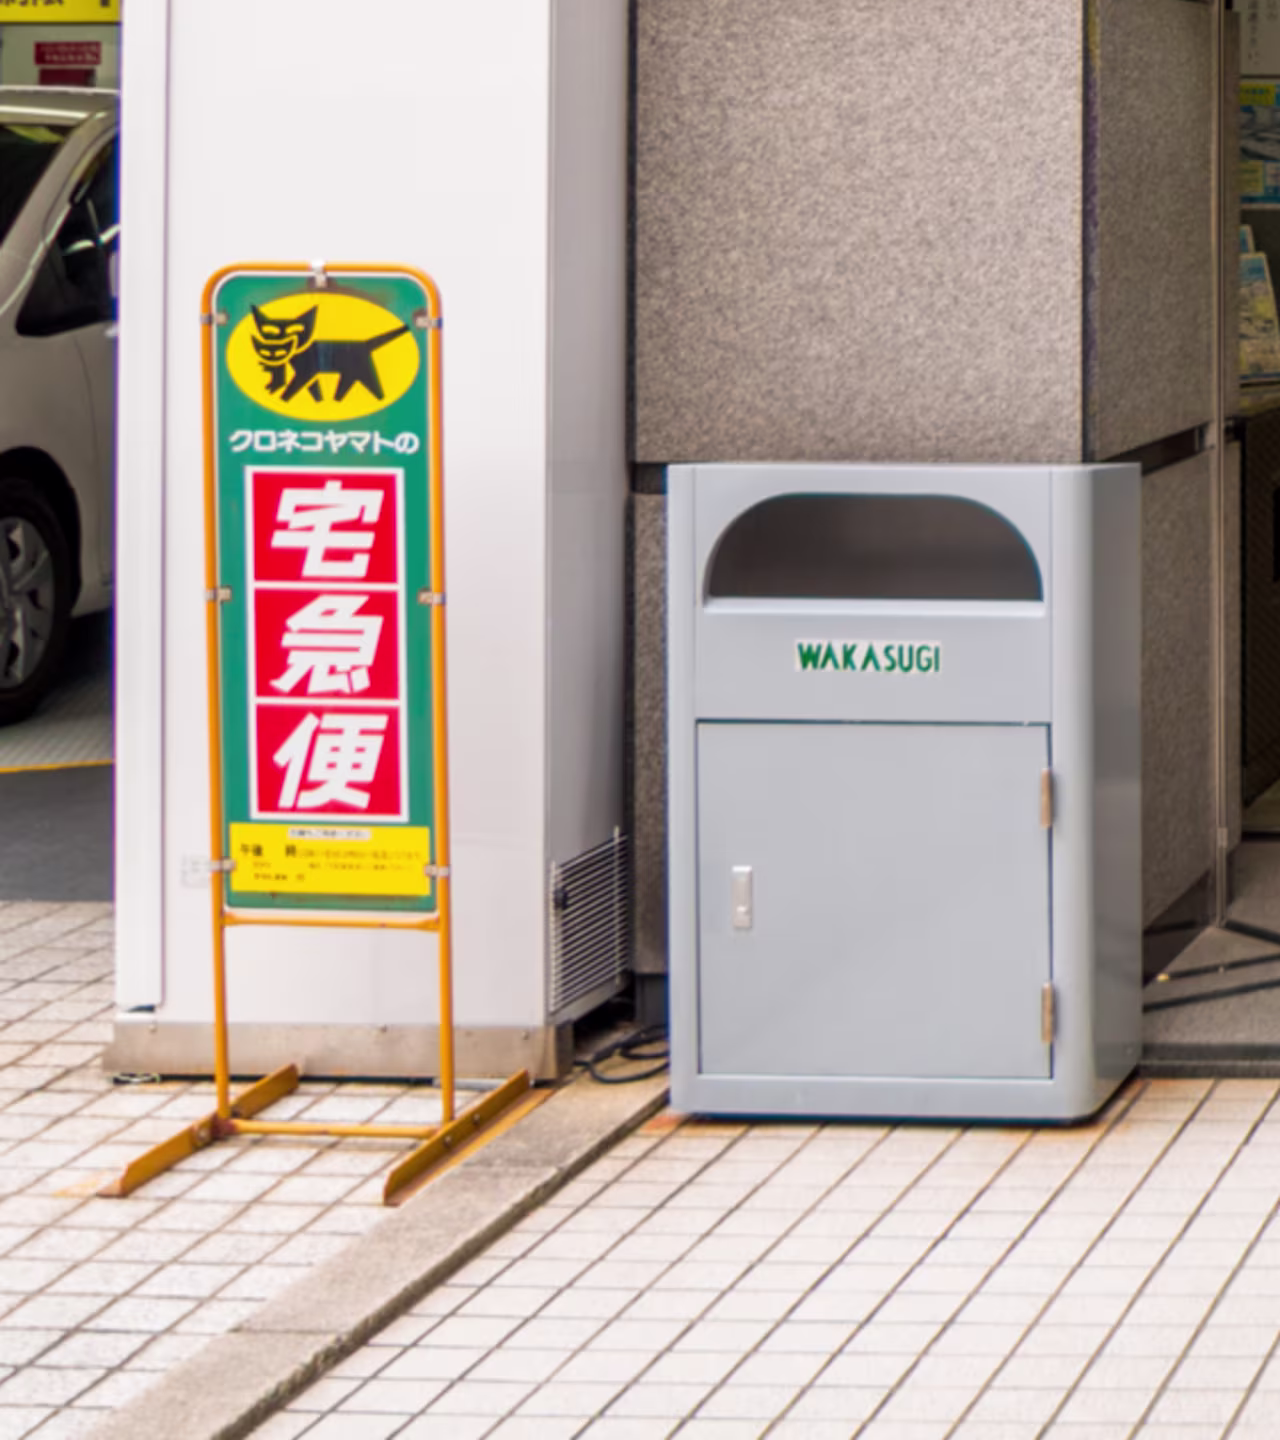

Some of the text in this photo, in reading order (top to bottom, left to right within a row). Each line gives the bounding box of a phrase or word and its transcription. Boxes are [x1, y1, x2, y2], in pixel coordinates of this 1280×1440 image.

[228, 429, 420, 455] クロネコヤマトの
[269, 479, 389, 810] 宅急便
[797, 641, 940, 673] WAKASUGI
